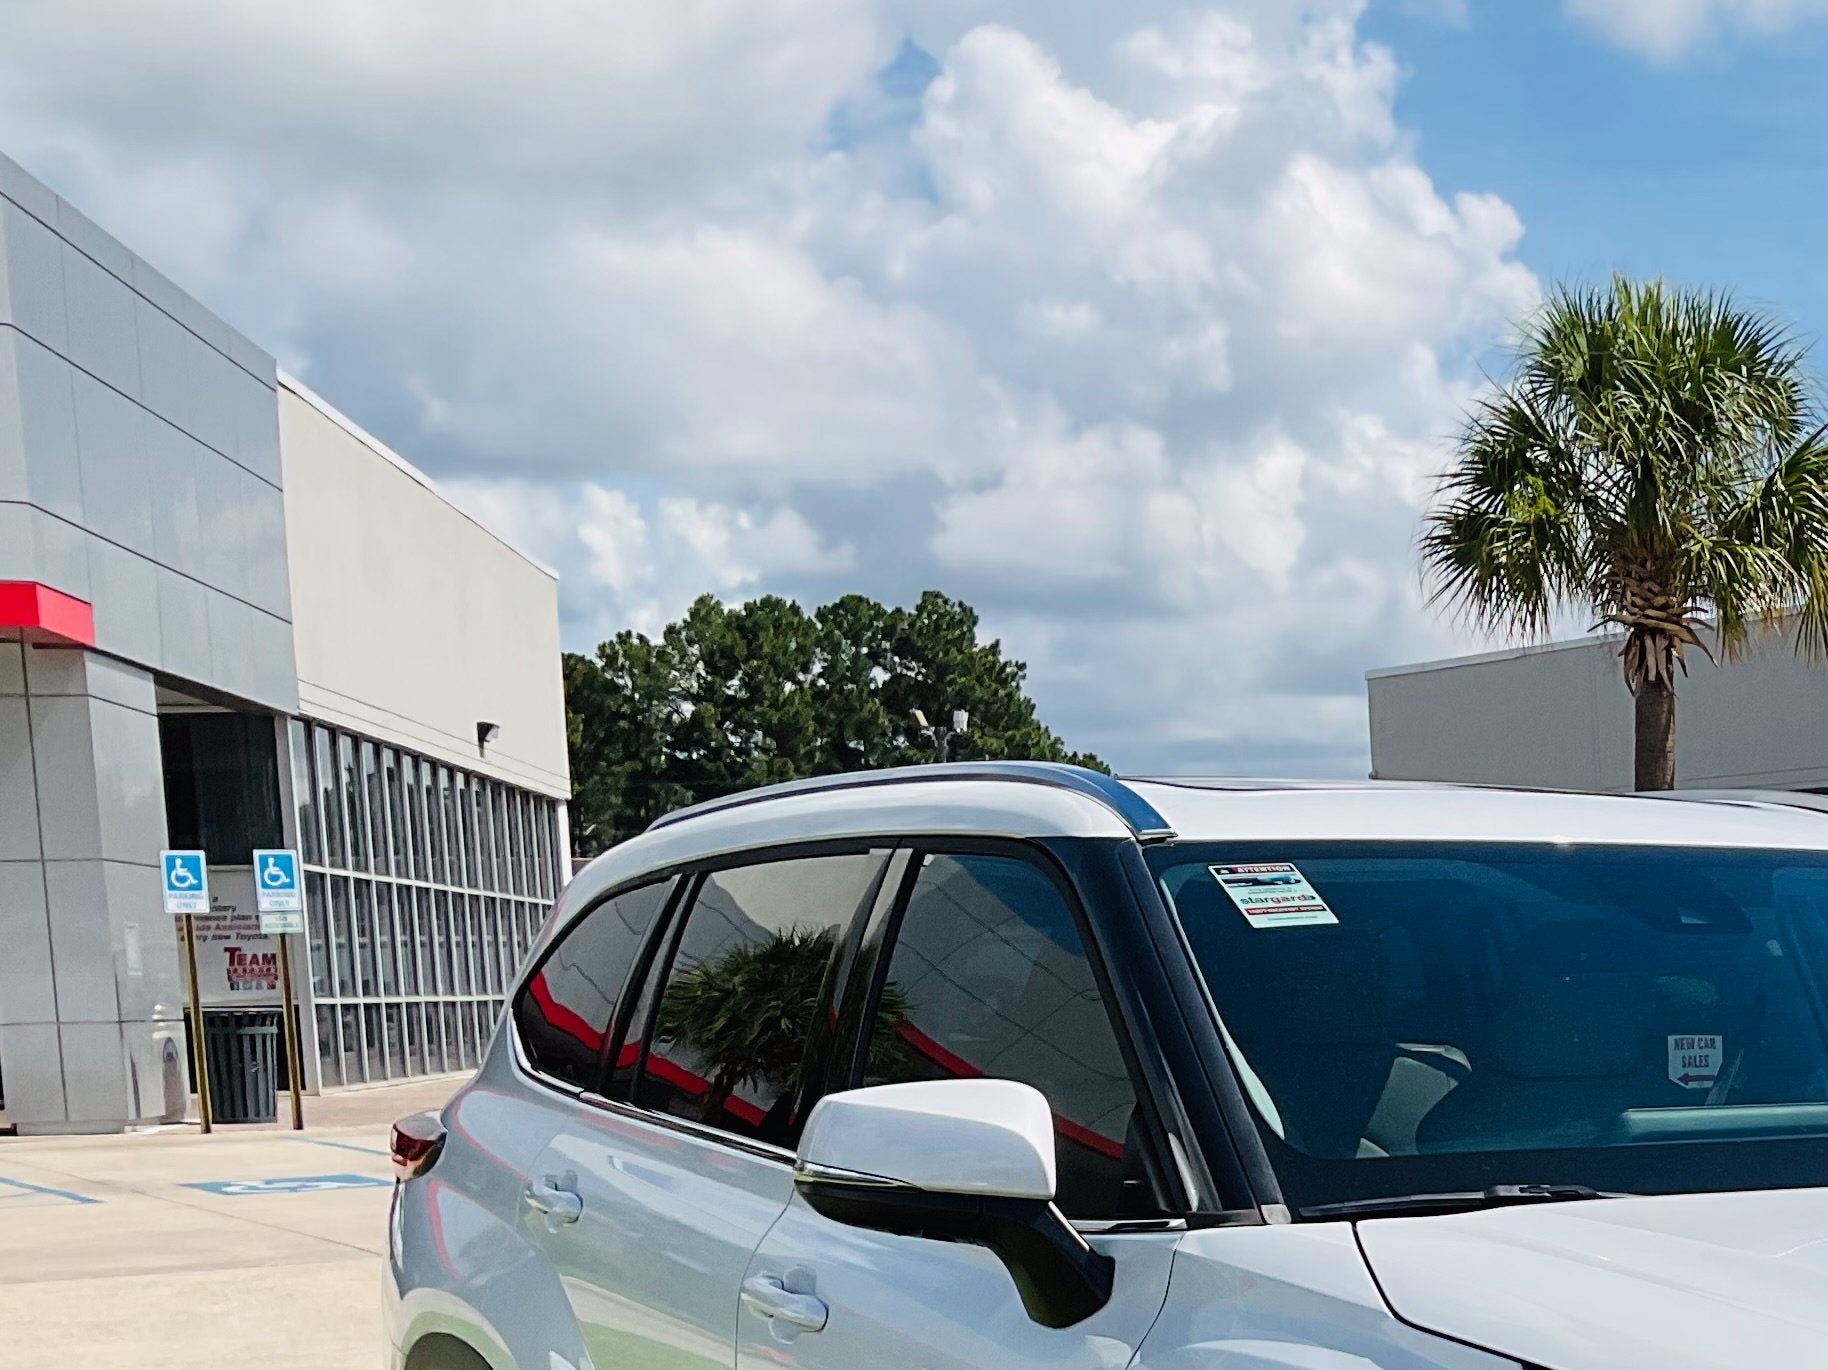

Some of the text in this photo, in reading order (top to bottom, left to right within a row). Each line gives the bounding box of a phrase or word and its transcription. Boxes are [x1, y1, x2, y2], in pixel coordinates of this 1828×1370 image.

[1237, 864, 1292, 873] ATTENTION
[223, 946, 277, 967] TEAM
[1673, 1036, 1717, 1051] NEW CAR
[1681, 1054, 1710, 1069] SALES
